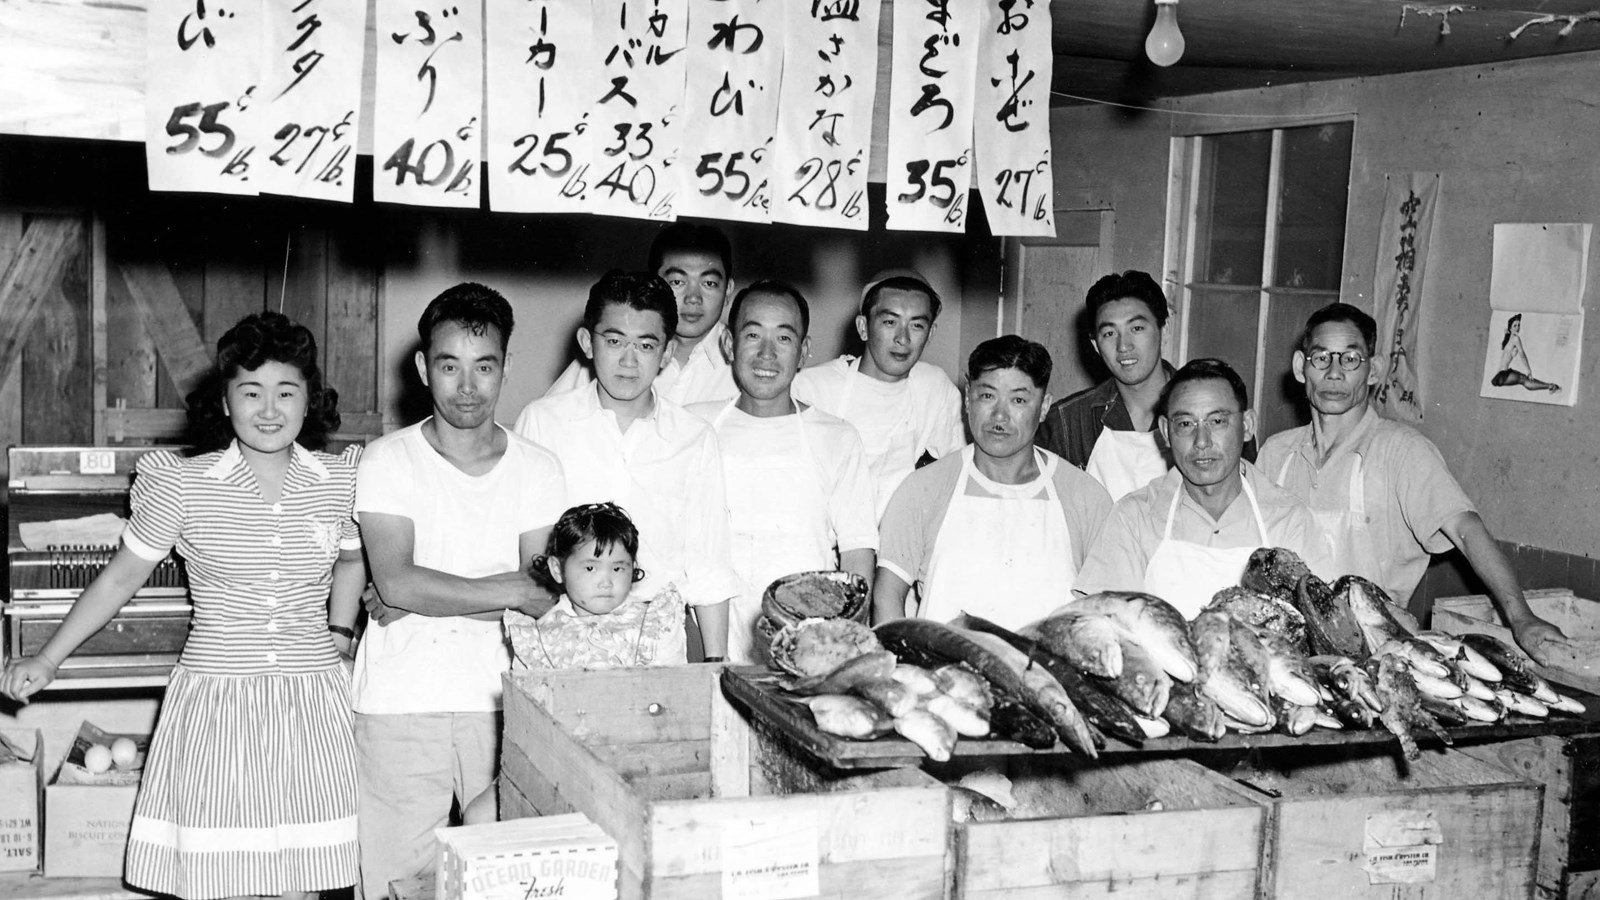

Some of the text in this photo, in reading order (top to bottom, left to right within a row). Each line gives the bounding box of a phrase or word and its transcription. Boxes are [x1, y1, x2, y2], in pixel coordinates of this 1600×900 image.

[645, 0, 687, 66] カル
[706, 0, 764, 117] わび
[68, 831, 105, 841] BISCUIT
[471, 859, 611, 893] OCEAN GARDEN
[519, 876, 565, 900] Fresh
